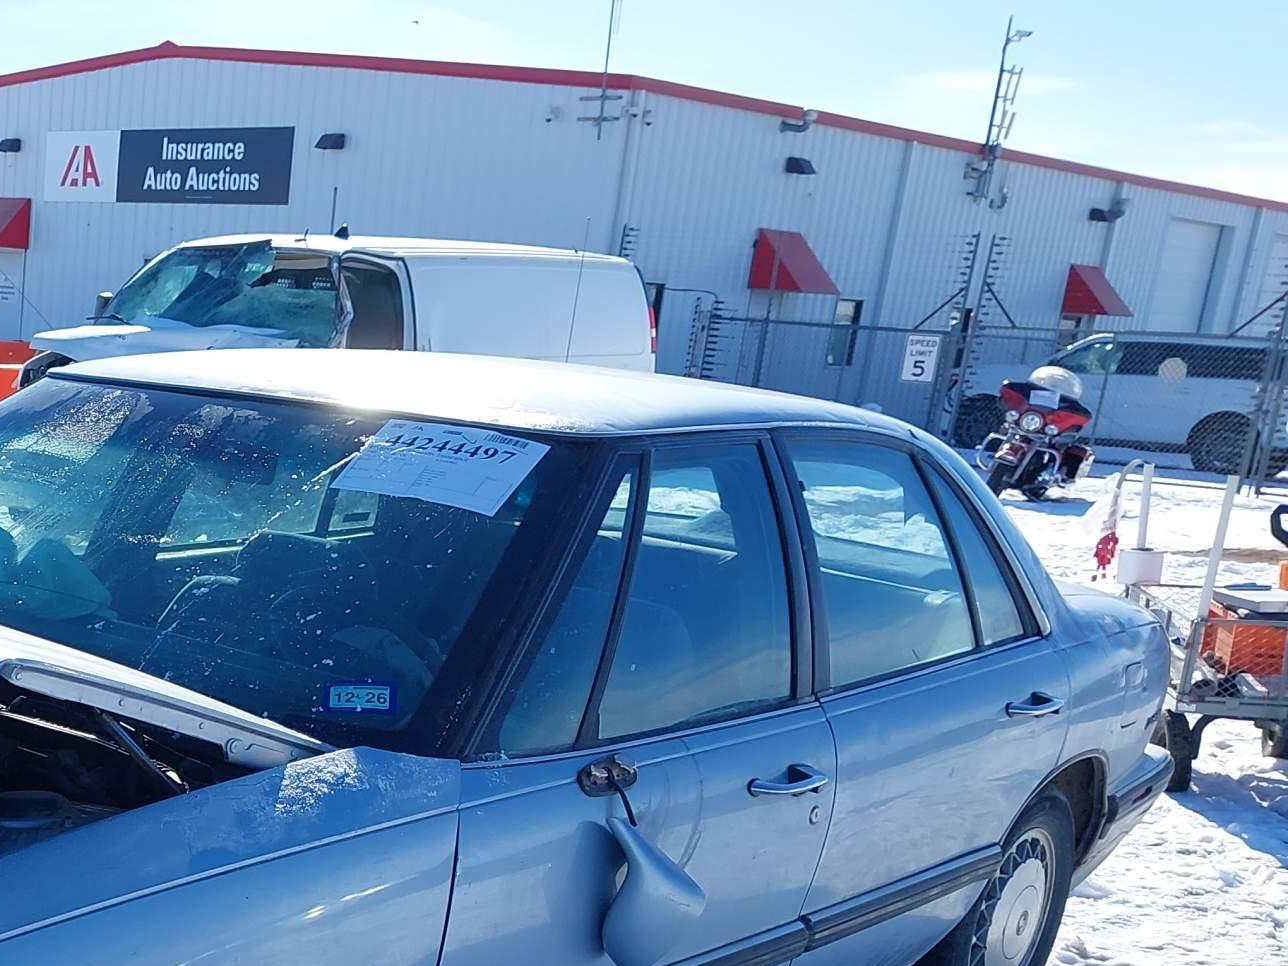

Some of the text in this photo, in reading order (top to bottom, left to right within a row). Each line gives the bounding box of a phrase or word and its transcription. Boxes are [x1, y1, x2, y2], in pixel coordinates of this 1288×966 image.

[162, 137, 245, 161] Insurance
[143, 166, 260, 192] Auto Auctions
[910, 338, 938, 348] SPEED
[911, 360, 926, 377] 5
[386, 434, 518, 464] 44244497
[334, 691, 388, 705] 12 26
